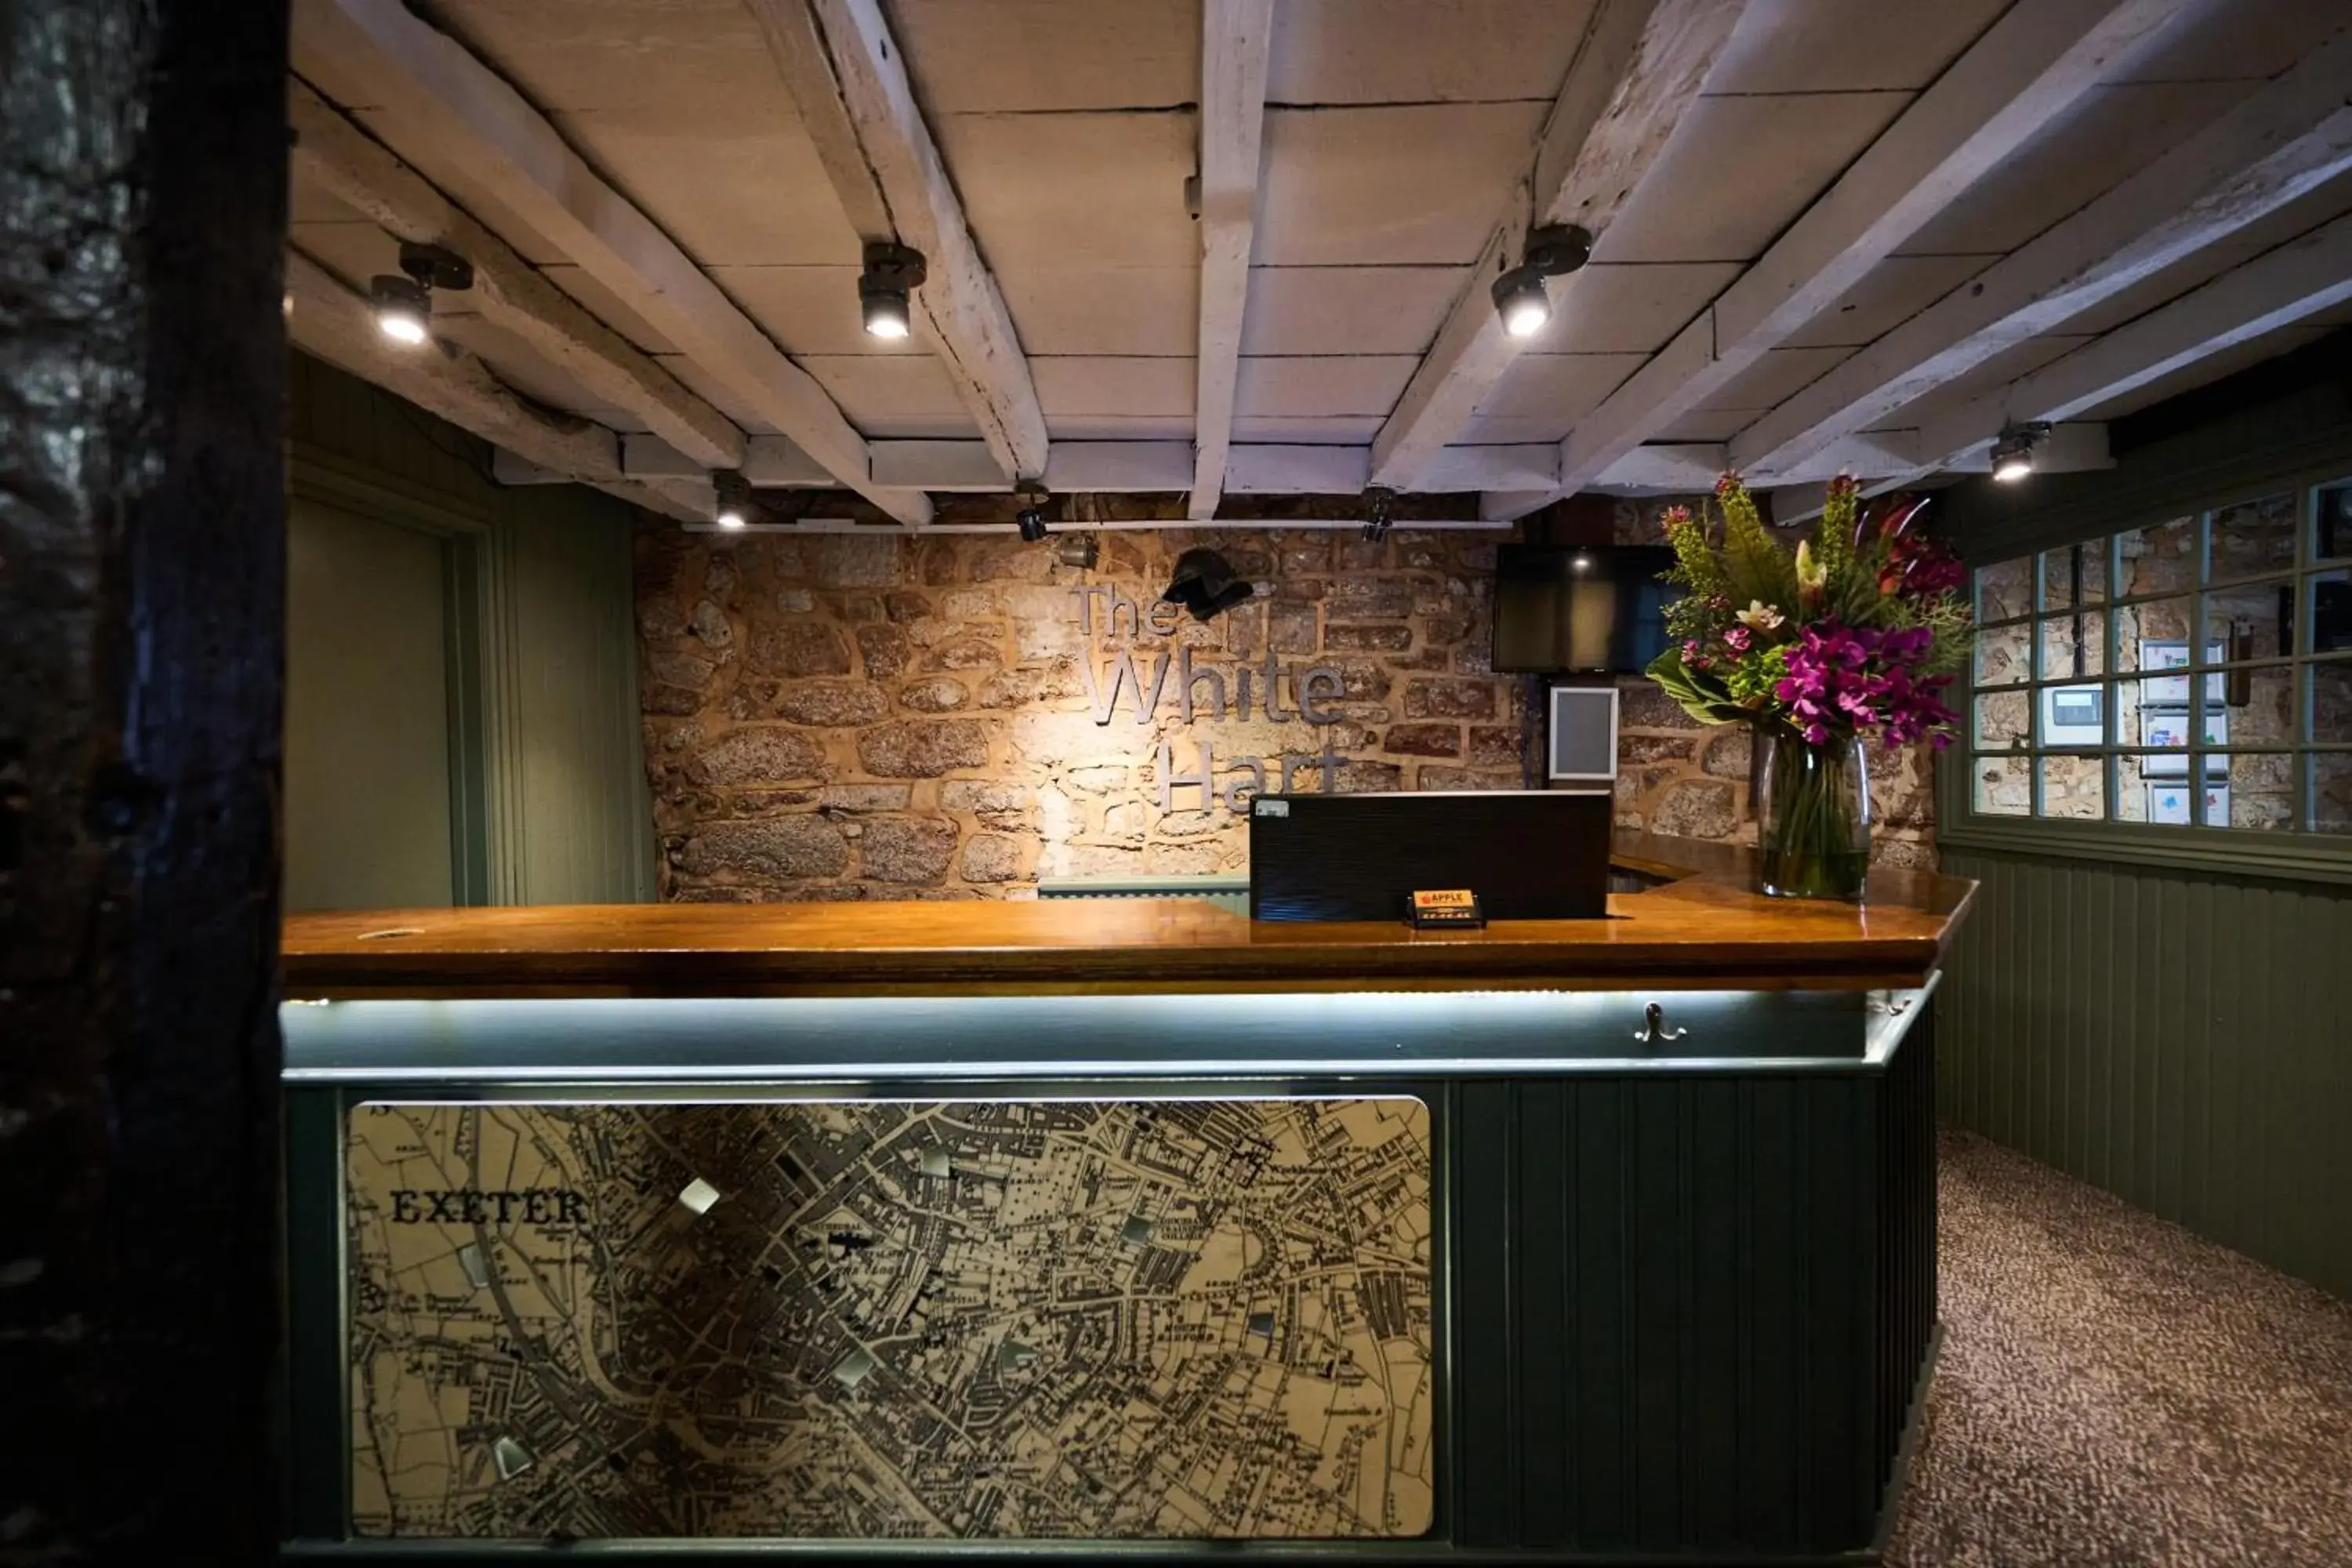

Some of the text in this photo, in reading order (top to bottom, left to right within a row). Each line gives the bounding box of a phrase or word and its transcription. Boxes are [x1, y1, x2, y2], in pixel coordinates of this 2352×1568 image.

[1070, 583, 1178, 637] The
[1078, 647, 1345, 725] White
[1158, 741, 1350, 815] Hart
[1432, 892, 1464, 902] APPLE
[390, 1187, 588, 1225] EXETER
